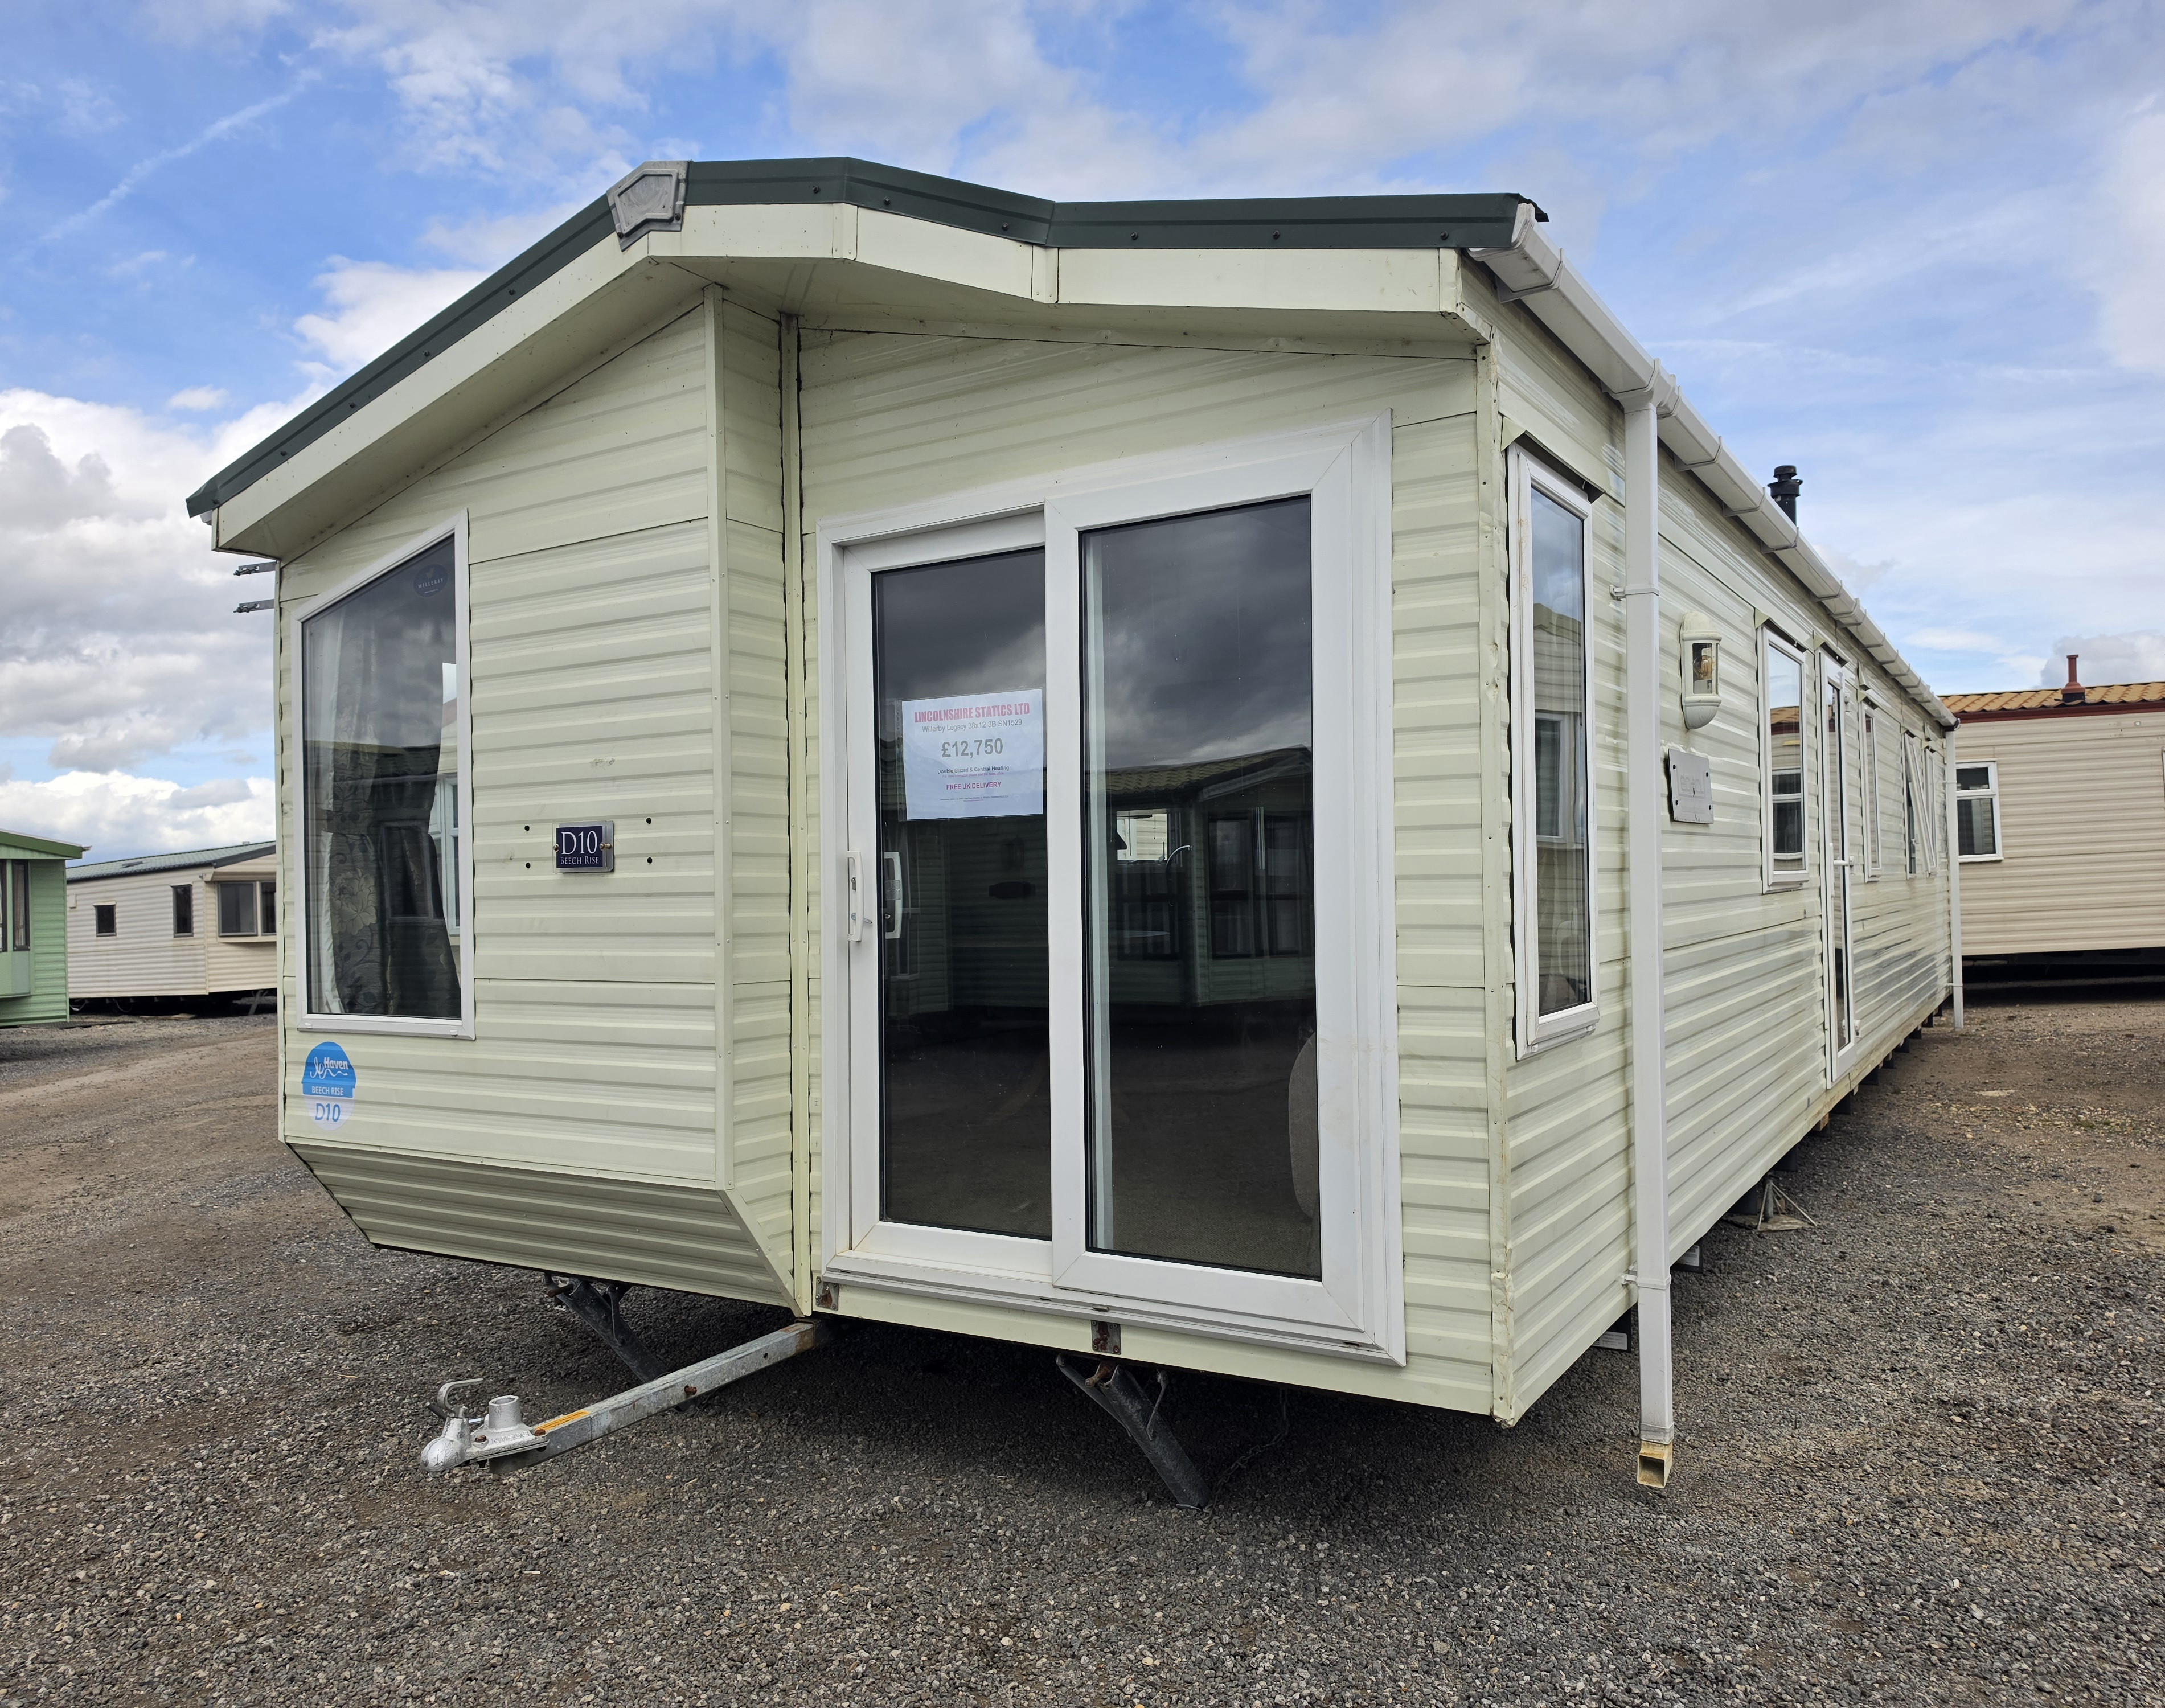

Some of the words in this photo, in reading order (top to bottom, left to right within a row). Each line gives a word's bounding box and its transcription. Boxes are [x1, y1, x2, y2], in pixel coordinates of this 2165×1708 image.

[418, 578, 444, 588] WILLERBY
[914, 707, 974, 723] LINCOLNSHIRE
[975, 704, 1012, 718] STATICS
[1014, 703, 1030, 715] LTD
[998, 718, 1022, 727] SN1529
[941, 738, 1003, 759] £12,750
[561, 830, 598, 855] D10
[560, 856, 581, 865] BEECH
[585, 856, 600, 864] RISE
[323, 1057, 349, 1070] Haven
[311, 1086, 330, 1095] BEECH
[331, 1087, 344, 1096] RISE
[315, 1103, 341, 1122] D10
